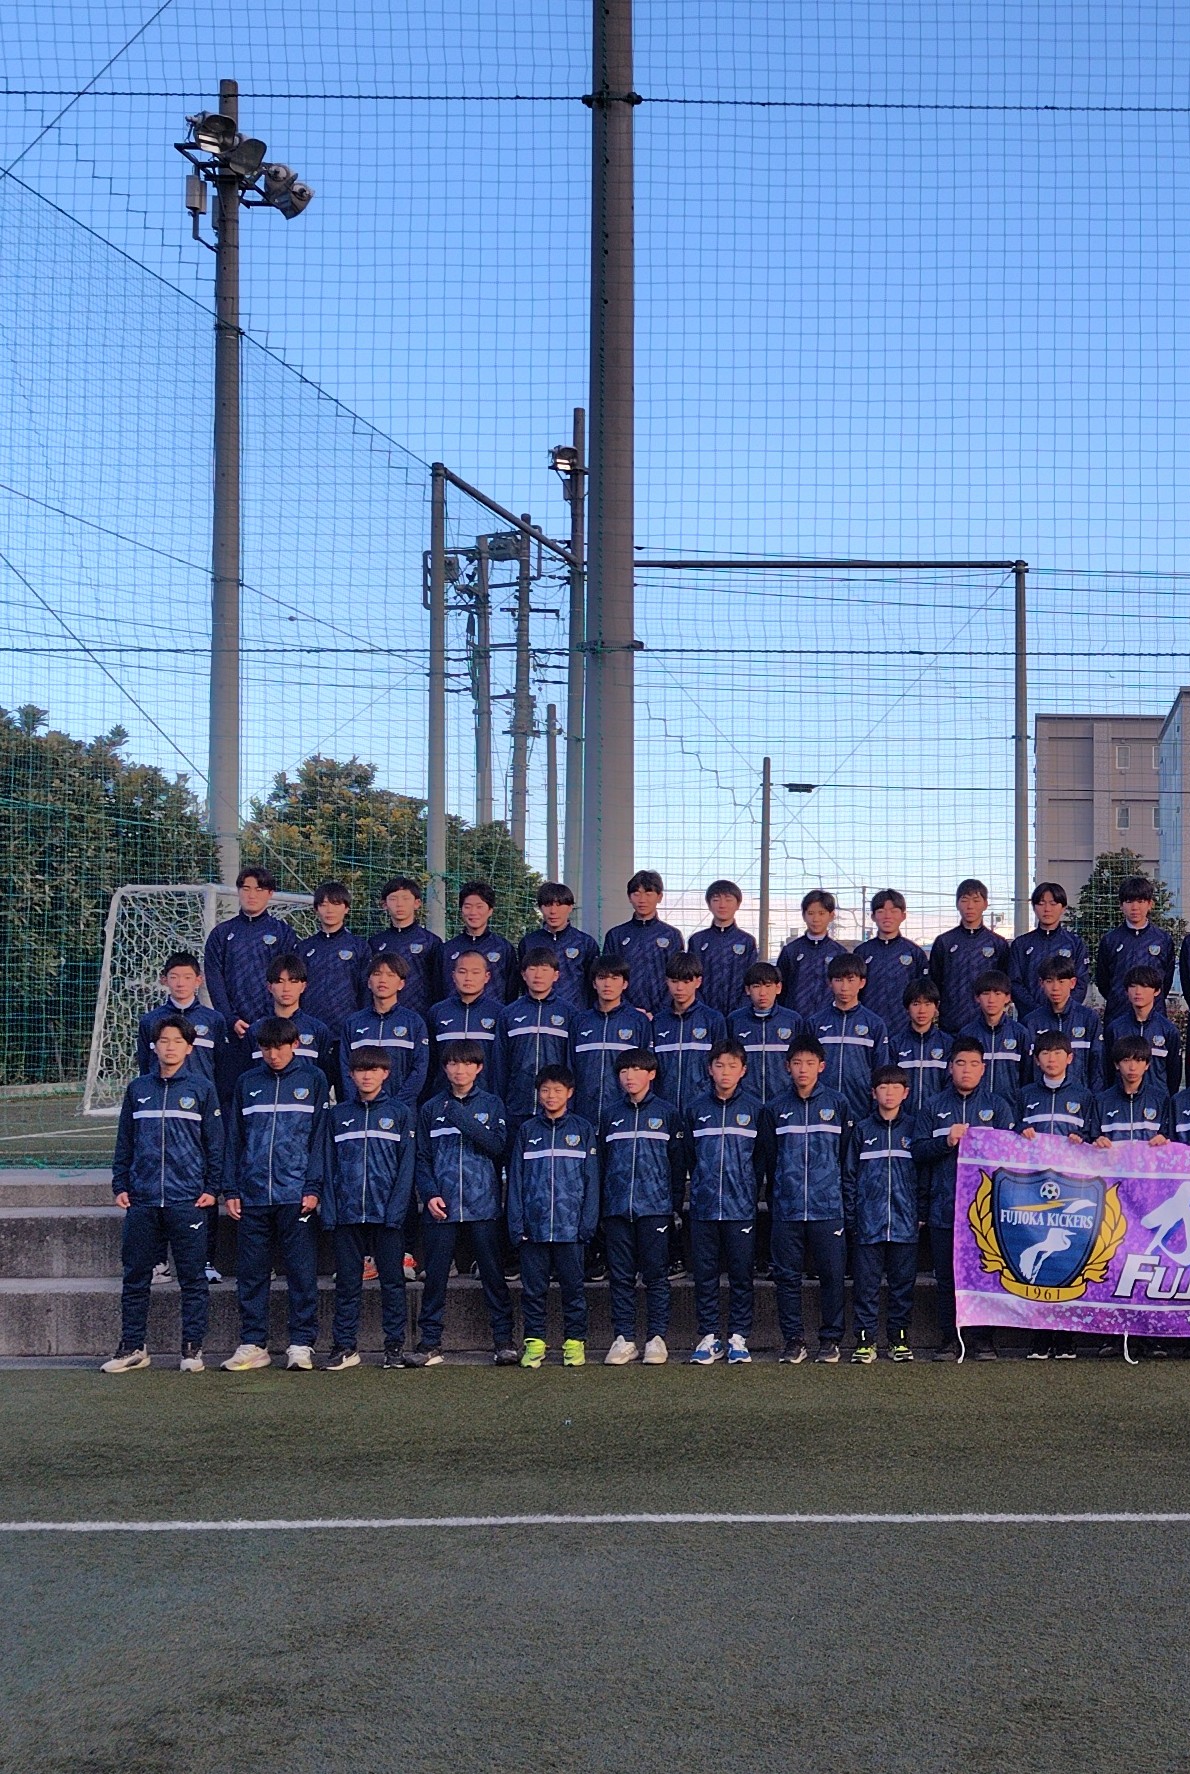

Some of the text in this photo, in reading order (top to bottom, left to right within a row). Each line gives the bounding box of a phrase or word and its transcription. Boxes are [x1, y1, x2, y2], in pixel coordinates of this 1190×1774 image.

[1000, 1209, 1094, 1229] FUJIOKA KICKERS
[1025, 1286, 1061, 1300] 1961
